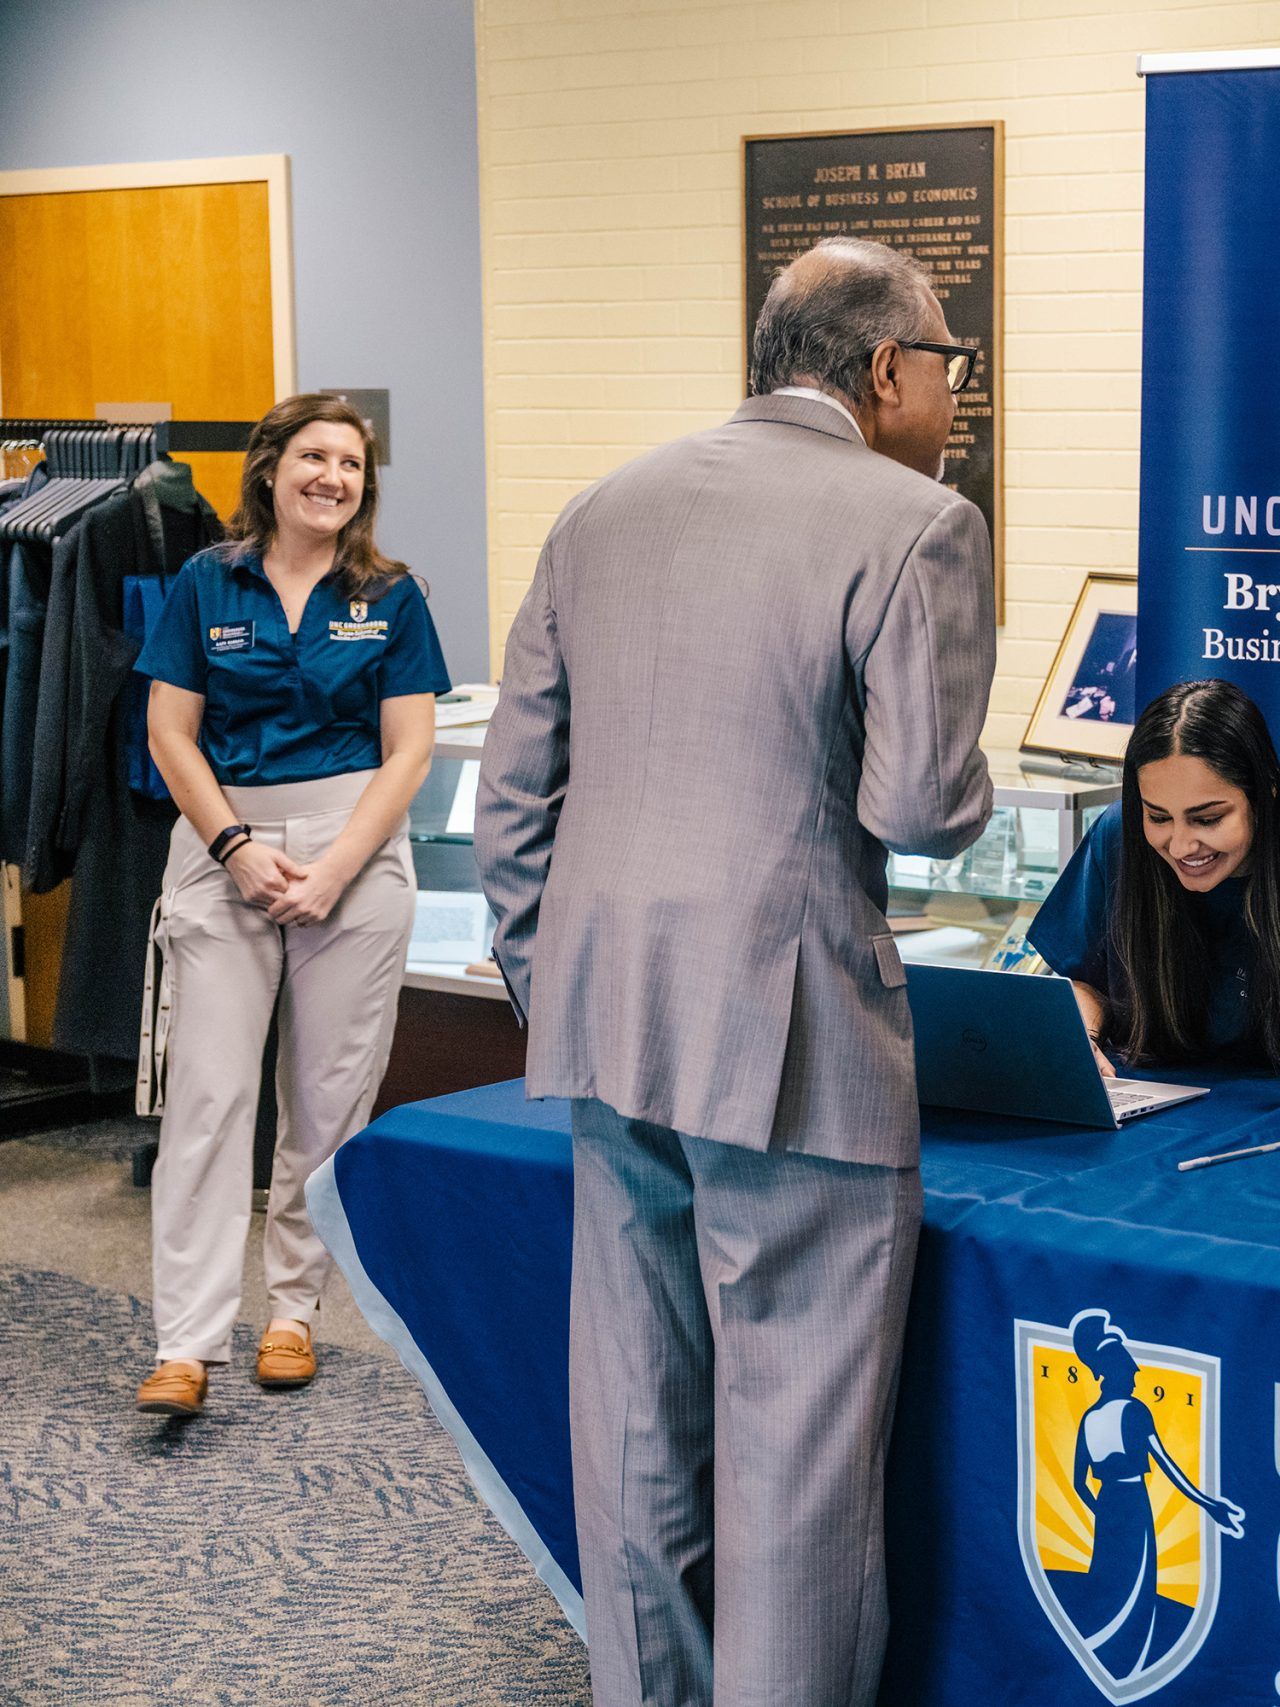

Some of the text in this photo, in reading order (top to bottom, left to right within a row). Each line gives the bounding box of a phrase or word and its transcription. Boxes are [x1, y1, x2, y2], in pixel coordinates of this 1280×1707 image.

[813, 164, 862, 184] JOSEPH
[885, 161, 927, 180] BRYAN
[761, 186, 978, 209] SCHOOL OF BUSINESS AND ECONOMICS
[911, 216, 945, 228] CAREER
[946, 215, 963, 226] AND
[963, 213, 981, 225] HAS
[906, 231, 952, 243] INSURANCE
[954, 230, 971, 241] AND
[915, 244, 962, 256] COMMUNITY
[955, 259, 981, 270] YEARS
